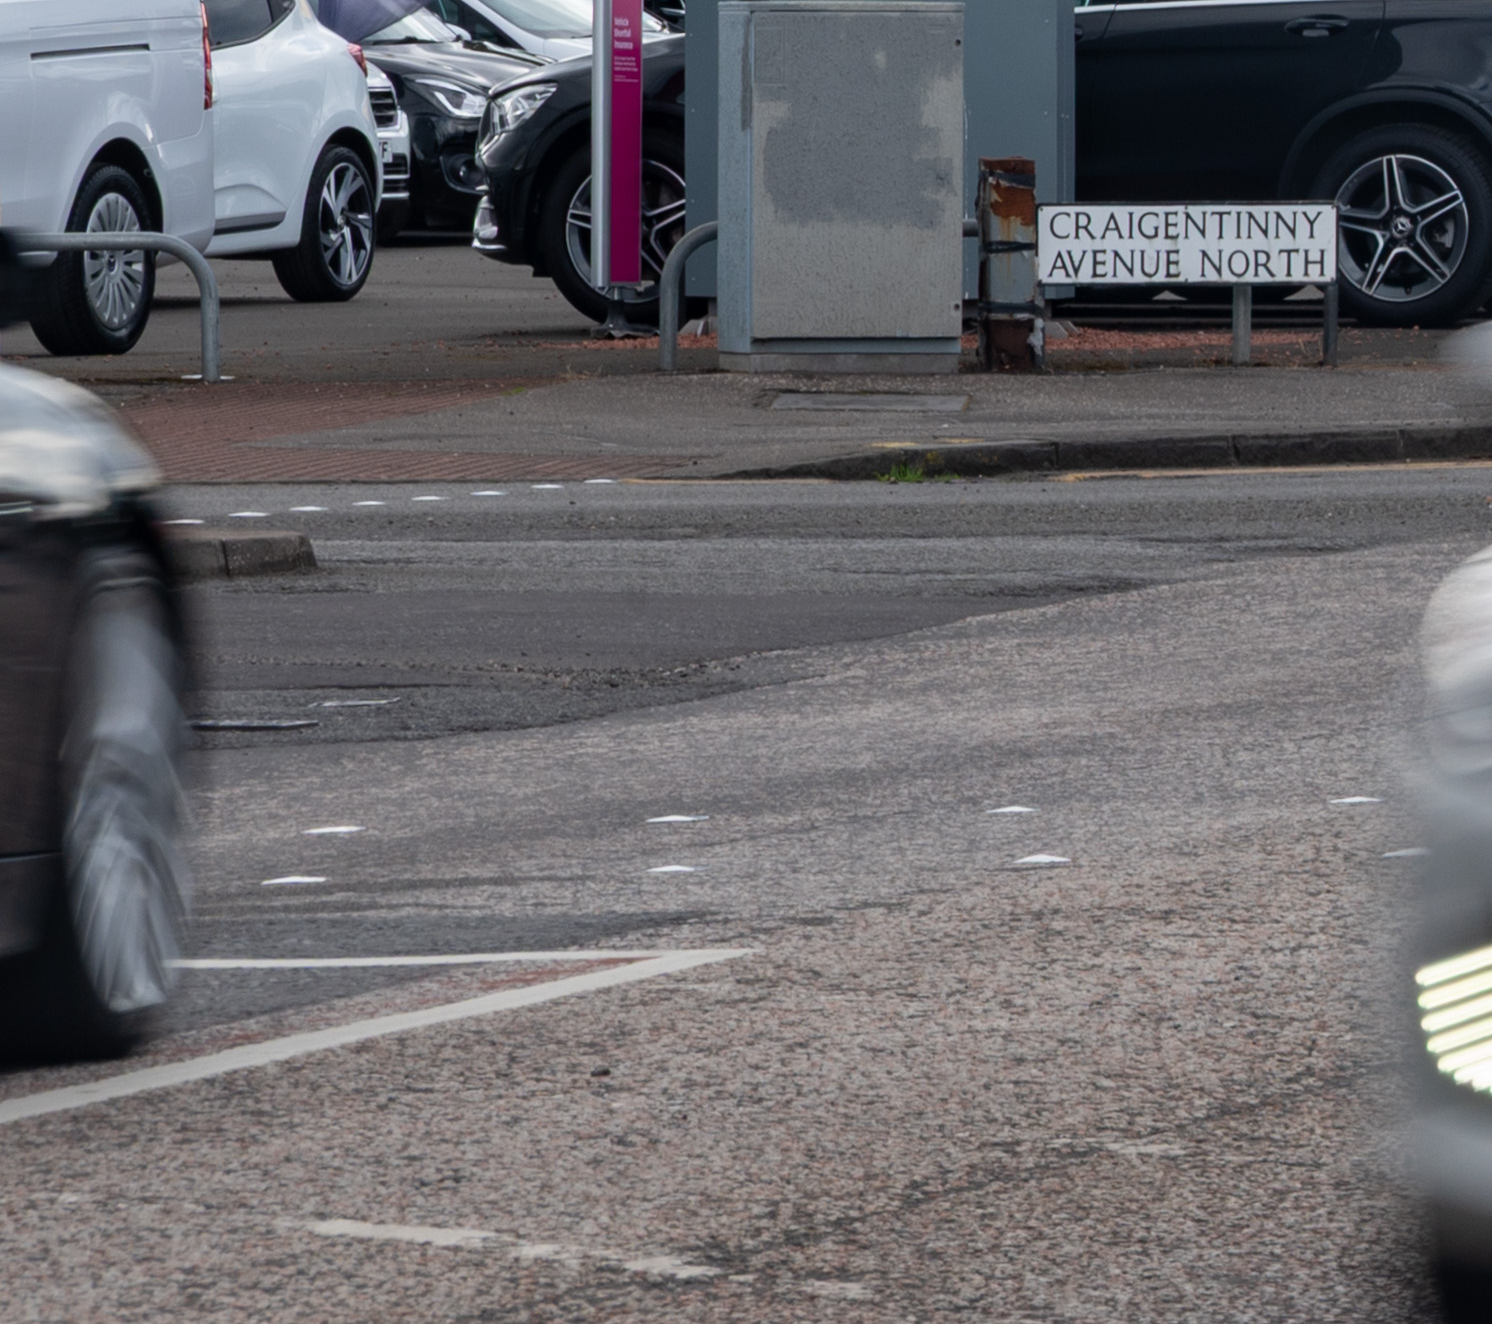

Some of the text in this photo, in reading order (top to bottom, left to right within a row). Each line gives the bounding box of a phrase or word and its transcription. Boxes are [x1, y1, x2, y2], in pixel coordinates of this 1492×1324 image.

[1050, 211, 1322, 240] CRAIGENTINNY
[1048, 249, 1326, 278] AVENUE NORTH
